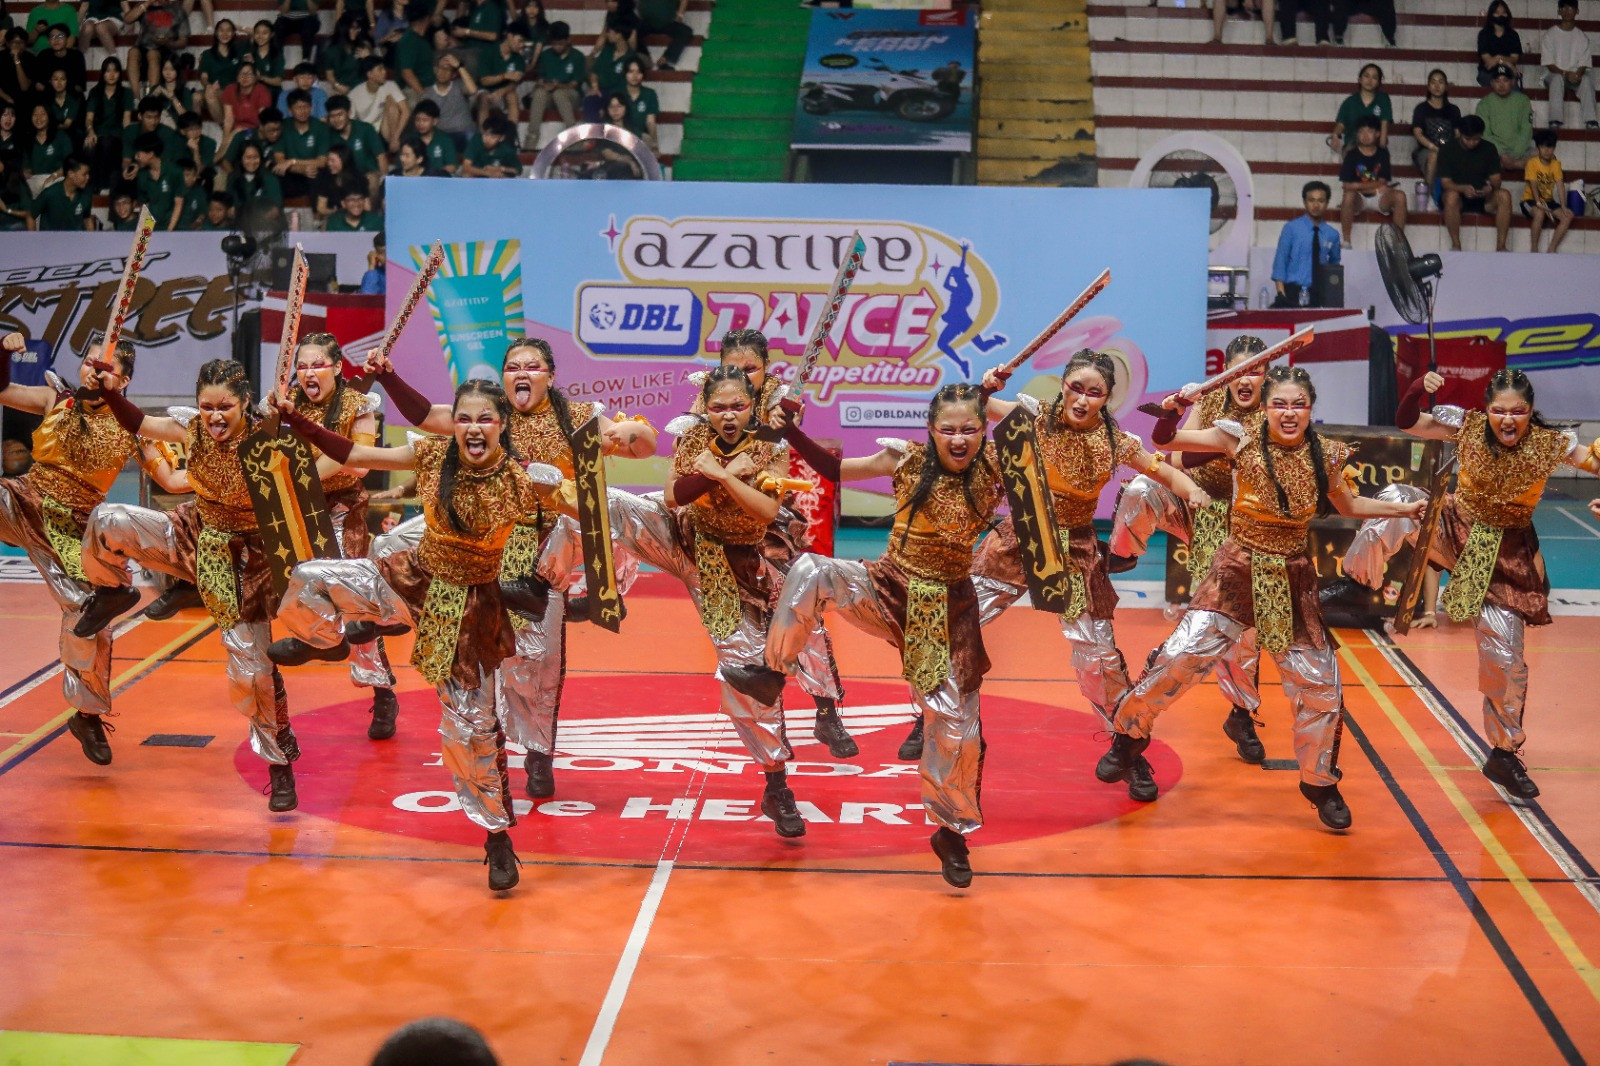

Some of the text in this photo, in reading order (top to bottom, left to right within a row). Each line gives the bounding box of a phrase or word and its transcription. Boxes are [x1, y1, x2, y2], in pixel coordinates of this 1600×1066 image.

[619, 303, 684, 332] DBL
[705, 288, 937, 361] DANCE
[449, 328, 503, 343] SUNSCREEN
[467, 340, 485, 351] GEL
[567, 378, 625, 397] GLOW
[632, 371, 672, 390] LIKE
[769, 359, 939, 400] Competition
[863, 409, 929, 420] @DBLDANC
